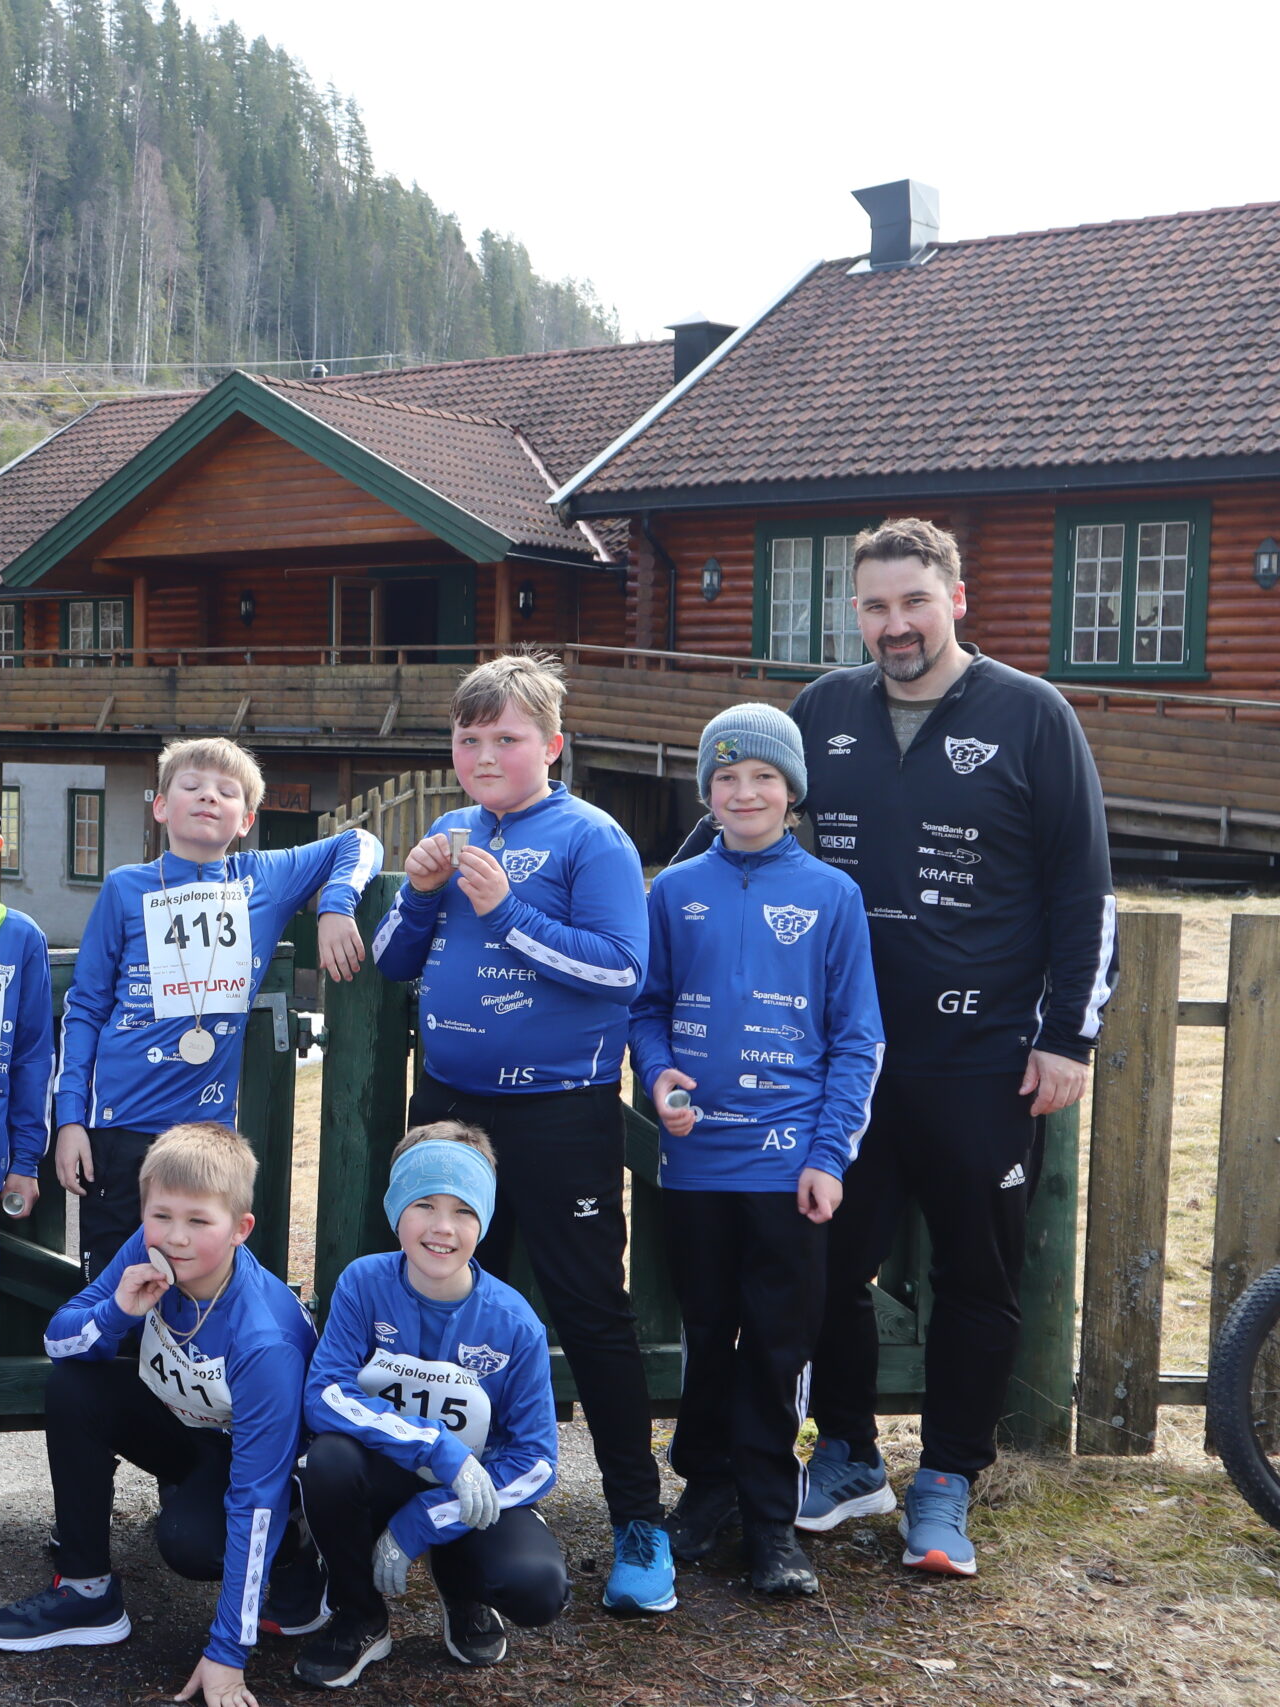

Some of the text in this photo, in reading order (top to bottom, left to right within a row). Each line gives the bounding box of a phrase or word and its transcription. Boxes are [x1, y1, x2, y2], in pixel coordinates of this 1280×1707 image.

[922, 821, 964, 834] SpareBank
[820, 835, 855, 849] CASA
[919, 867, 974, 885] KRAFER
[220, 890, 242, 901] 2023
[164, 911, 237, 950] 413
[477, 966, 537, 981] KRAFER
[163, 980, 240, 996] RETURA
[481, 990, 524, 1007] Montebello
[753, 990, 793, 1003] SpareBank
[937, 990, 981, 1014] GE
[496, 998, 534, 1013] Camping
[673, 1020, 707, 1037] CASA
[740, 1049, 795, 1065] KRAFER
[498, 1067, 535, 1086] HS
[198, 1081, 226, 1106] ØS
[762, 1127, 797, 1150] AS
[1000, 1176, 1026, 1189] adidas
[150, 1352, 214, 1408] 411
[192, 1368, 222, 1381] 2023
[378, 1382, 468, 1432] 415
